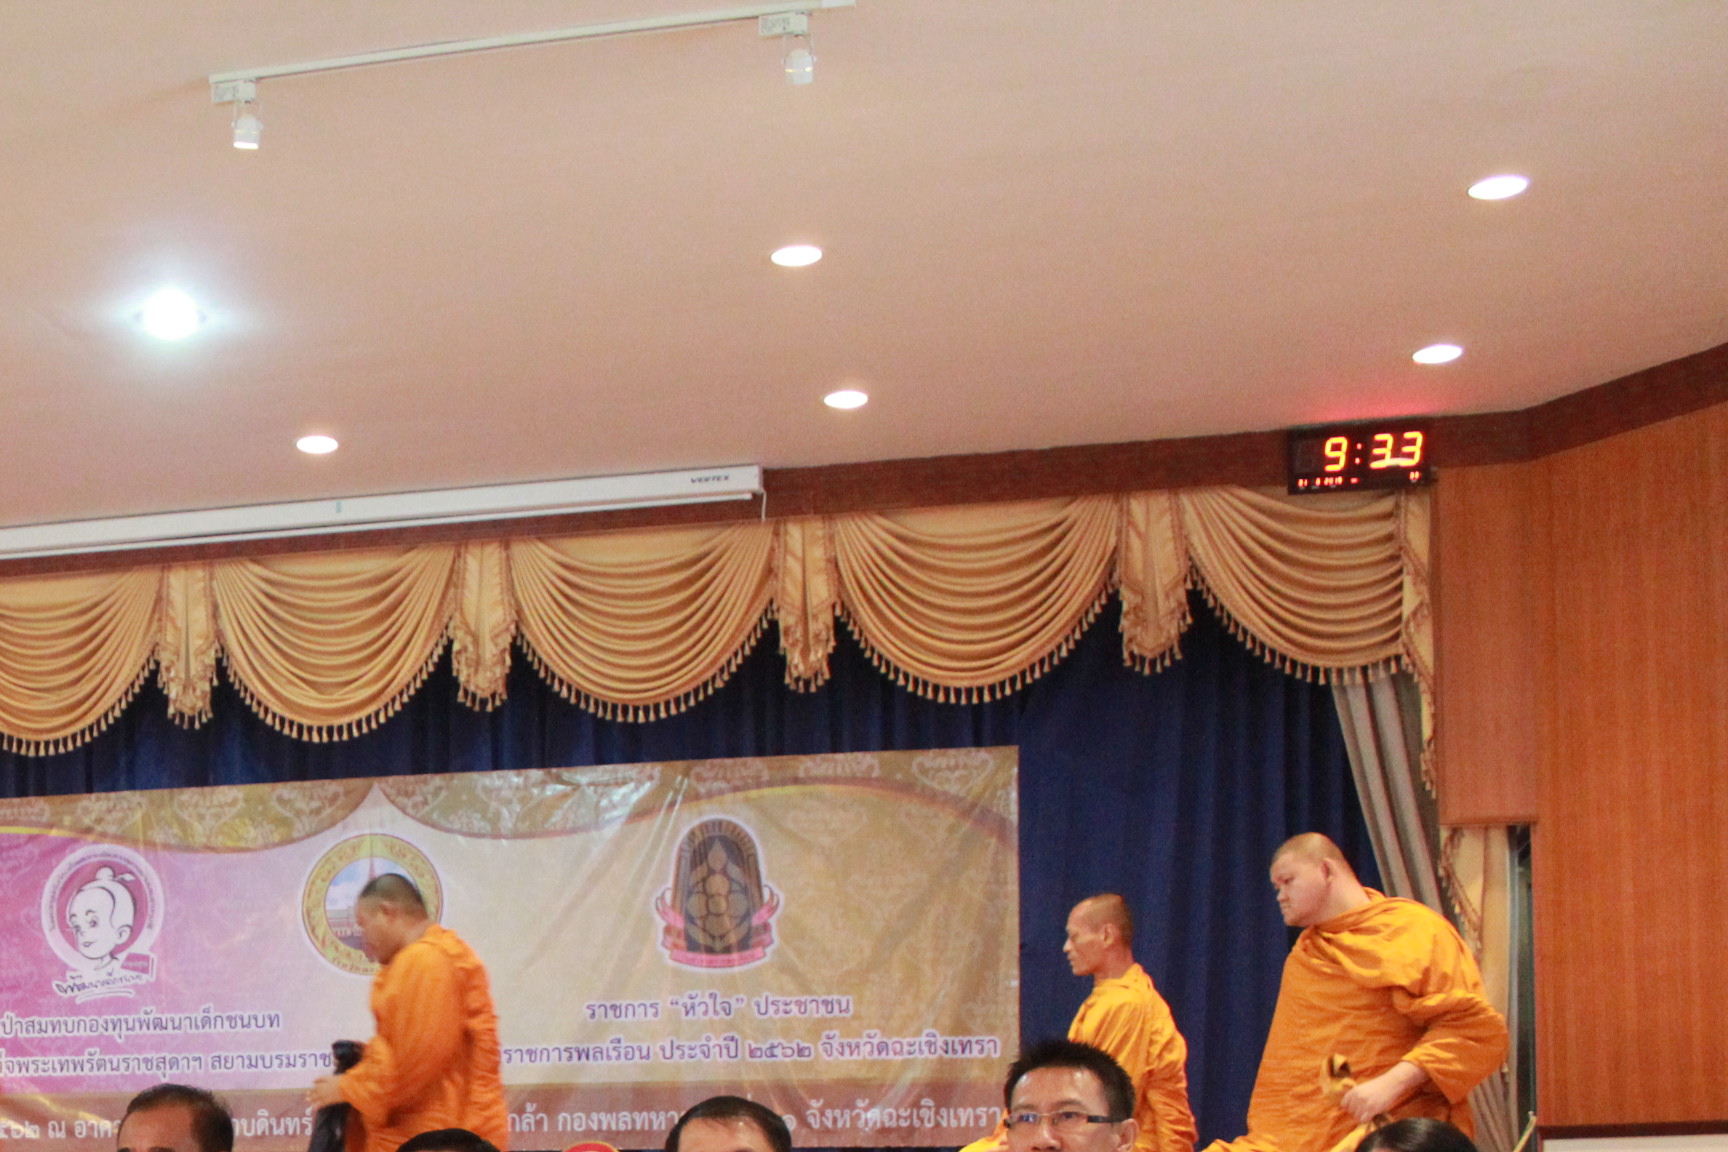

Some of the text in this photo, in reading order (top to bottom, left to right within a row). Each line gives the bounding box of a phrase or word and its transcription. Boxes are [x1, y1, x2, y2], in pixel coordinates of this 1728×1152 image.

[1324, 431, 1423, 472] 9:33
[585, 1001, 660, 1020] ราชการ
[754, 995, 851, 1016] ประชาชน
[659, 1036, 740, 1061] ประจำปี
[747, 1042, 813, 1059] ๒๕๖๒
[821, 1033, 999, 1058] จังหวัดฉะเชิงเทรา
[47, 1120, 67, 1139] ณ
[558, 1109, 685, 1132] กองพลทหา
[806, 1098, 1001, 1129] จังหวัดฉะเชิงเทรา
